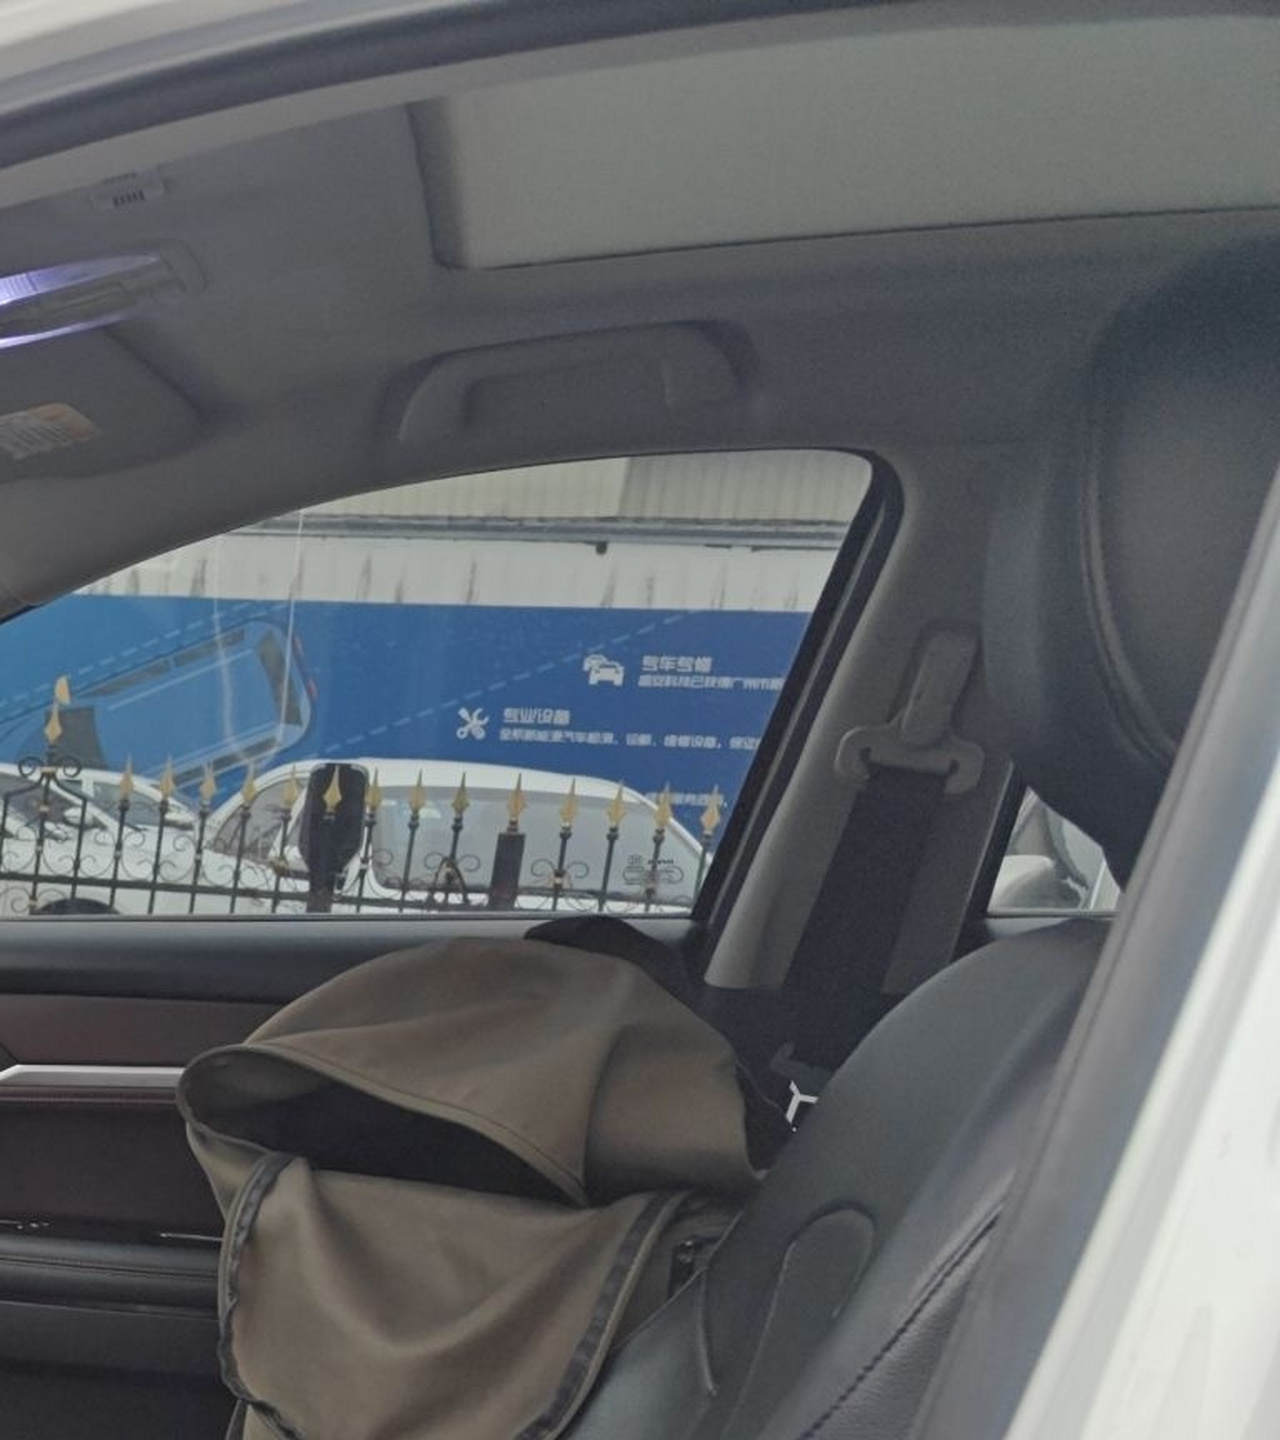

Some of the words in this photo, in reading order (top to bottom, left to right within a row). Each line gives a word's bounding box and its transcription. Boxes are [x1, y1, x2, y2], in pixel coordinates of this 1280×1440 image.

[642, 655, 713, 673] 专车专修
[503, 707, 570, 726] 专业设备
